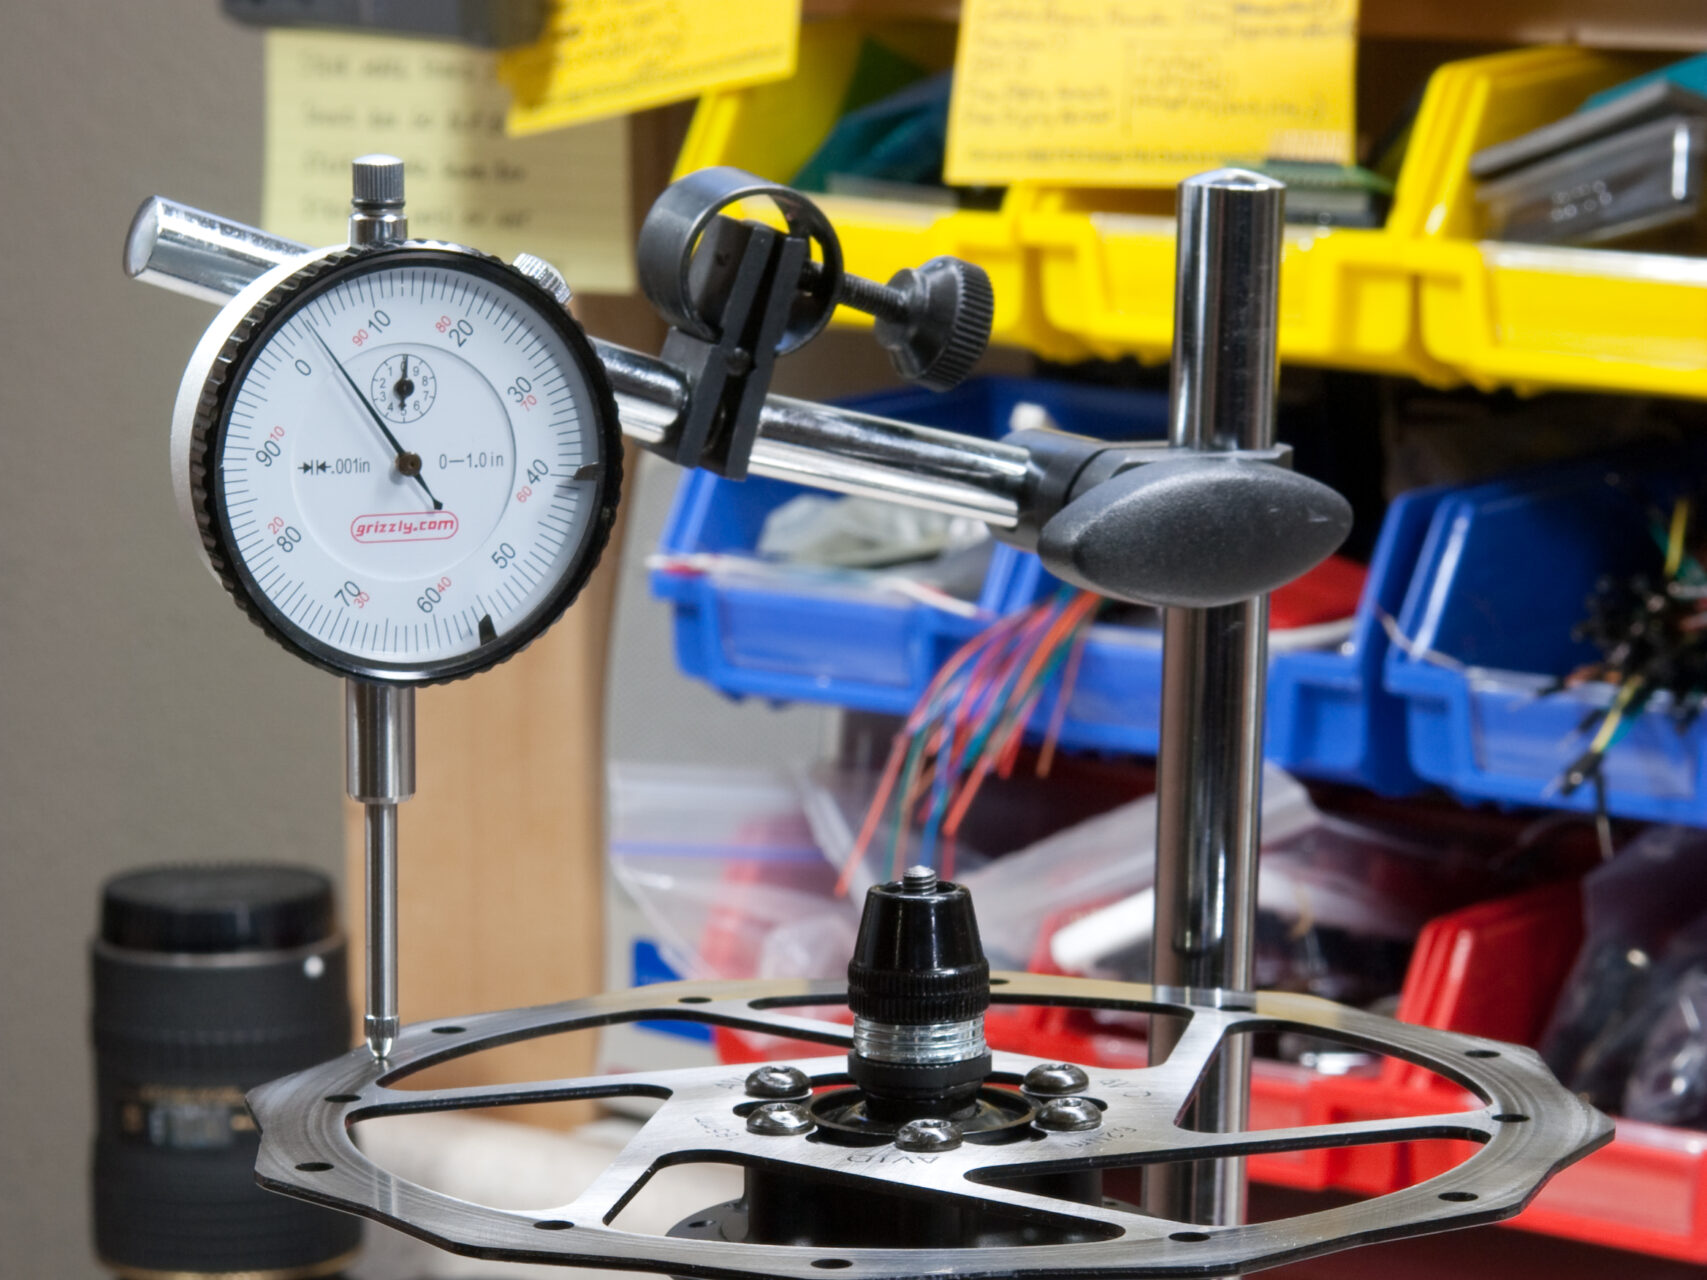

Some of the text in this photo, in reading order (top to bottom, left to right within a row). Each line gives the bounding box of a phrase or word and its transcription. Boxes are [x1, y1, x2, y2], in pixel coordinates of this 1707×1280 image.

[368, 309, 391, 333] 10
[435, 315, 452, 333] 80
[352, 328, 369, 347] 90
[449, 319, 474, 347] 20
[294, 358, 312, 376] 0
[507, 376, 532, 403] 30
[520, 394, 537, 412] 70
[269, 425, 285, 441] 10
[255, 440, 281, 467] 90
[527, 459, 549, 484] 40
[516, 485, 532, 503] 60
[267, 516, 284, 535] 20
[355, 519, 455, 537] grizzly.com
[276, 526, 302, 553] 80
[491, 542, 516, 569] 50
[334, 580, 361, 607] 70
[436, 576, 452, 594] 40
[353, 591, 370, 609] 30
[416, 586, 442, 614] 60
